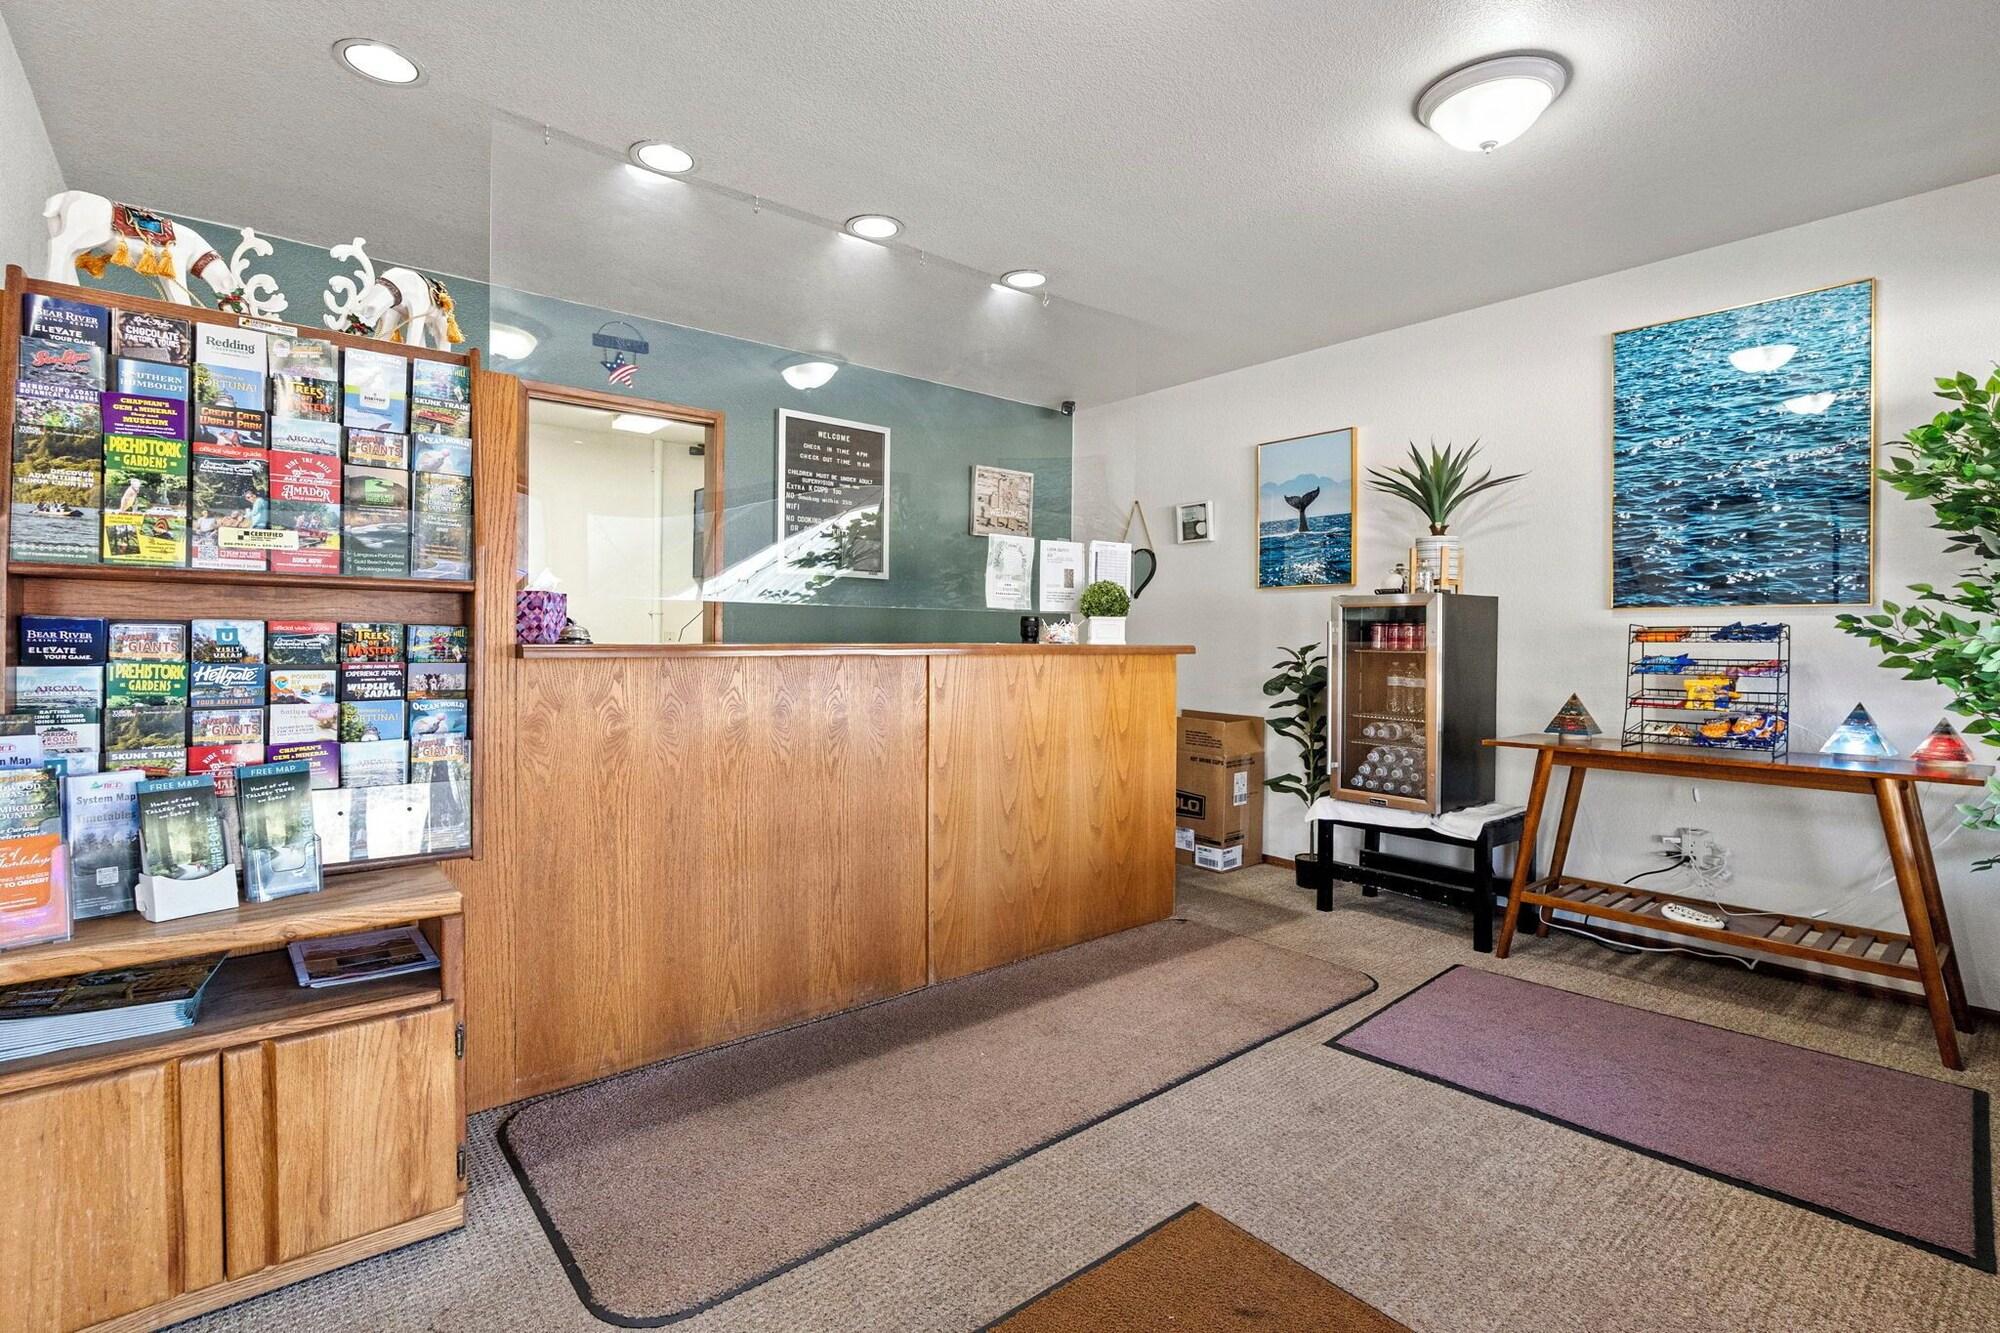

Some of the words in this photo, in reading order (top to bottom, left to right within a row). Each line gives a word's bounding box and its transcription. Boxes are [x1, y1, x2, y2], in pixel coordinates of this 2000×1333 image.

[65, 311, 99, 325] RIVER
[34, 324, 82, 338] ELEVATE
[126, 325, 180, 341] CHOCOLATE
[50, 334, 72, 342] YOUR
[206, 336, 256, 354] Redding
[20, 382, 70, 393] MENDOCINO
[74, 389, 98, 397] COAST
[288, 381, 326, 400] TREES
[113, 404, 132, 412] GEM
[138, 406, 178, 416] MINERAL
[414, 398, 442, 407] SKUNK
[444, 402, 468, 411] TRAIN
[123, 416, 168, 426] MUSEUM
[286, 434, 328, 445] ARCATA
[818, 431, 851, 443] WELCOME
[110, 436, 182, 458] PREHISTORIC
[360, 444, 401, 457] GIANTS
[803, 443, 821, 451] CHECK
[836, 448, 850, 456] TIME
[123, 455, 168, 469] GARDENS
[836, 458, 852, 466] TIME
[788, 468, 813, 477] CHILDREN
[816, 472, 830, 480] MUST
[840, 475, 856, 483] UNDER
[802, 478, 834, 486] SUPERVISION
[282, 484, 334, 504] AMADOR
[786, 502, 800, 510] WIFI
[786, 514, 795, 522] NO
[250, 530, 284, 538] CERTIFIED
[26, 630, 57, 639] BEAR
[60, 630, 92, 640] RIVER
[221, 632, 233, 642] U
[355, 629, 390, 643] TREES
[453, 628, 465, 638] HILL
[28, 646, 77, 654] ELEVATE
[128, 642, 178, 653] GIANTS
[348, 643, 398, 658] MYSTERY
[116, 663, 185, 680] PREHISTORIC
[193, 666, 258, 688] Hellgate
[34, 685, 86, 694] ARCATA
[128, 680, 172, 692] GARDENS
[346, 682, 396, 691] WILDLIFE
[364, 690, 402, 698] SAFARI
[412, 702, 440, 712] OCEAN
[440, 700, 465, 709] WORLD
[212, 724, 259, 736] GIANTS
[111, 752, 148, 761] SKUNK
[151, 750, 185, 760] TRAIN
[422, 746, 462, 757] GIANTS
[10, 756, 32, 766] Map
[250, 767, 274, 777] FREE
[275, 765, 296, 774] MAP
[150, 782, 175, 792] FREE
[176, 780, 200, 788] MAP
[274, 786, 296, 794] TREES
[76, 794, 113, 806] System
[116, 793, 136, 803] Map
[176, 800, 200, 810] TREES
[0, 812, 36, 820] OUNTY
